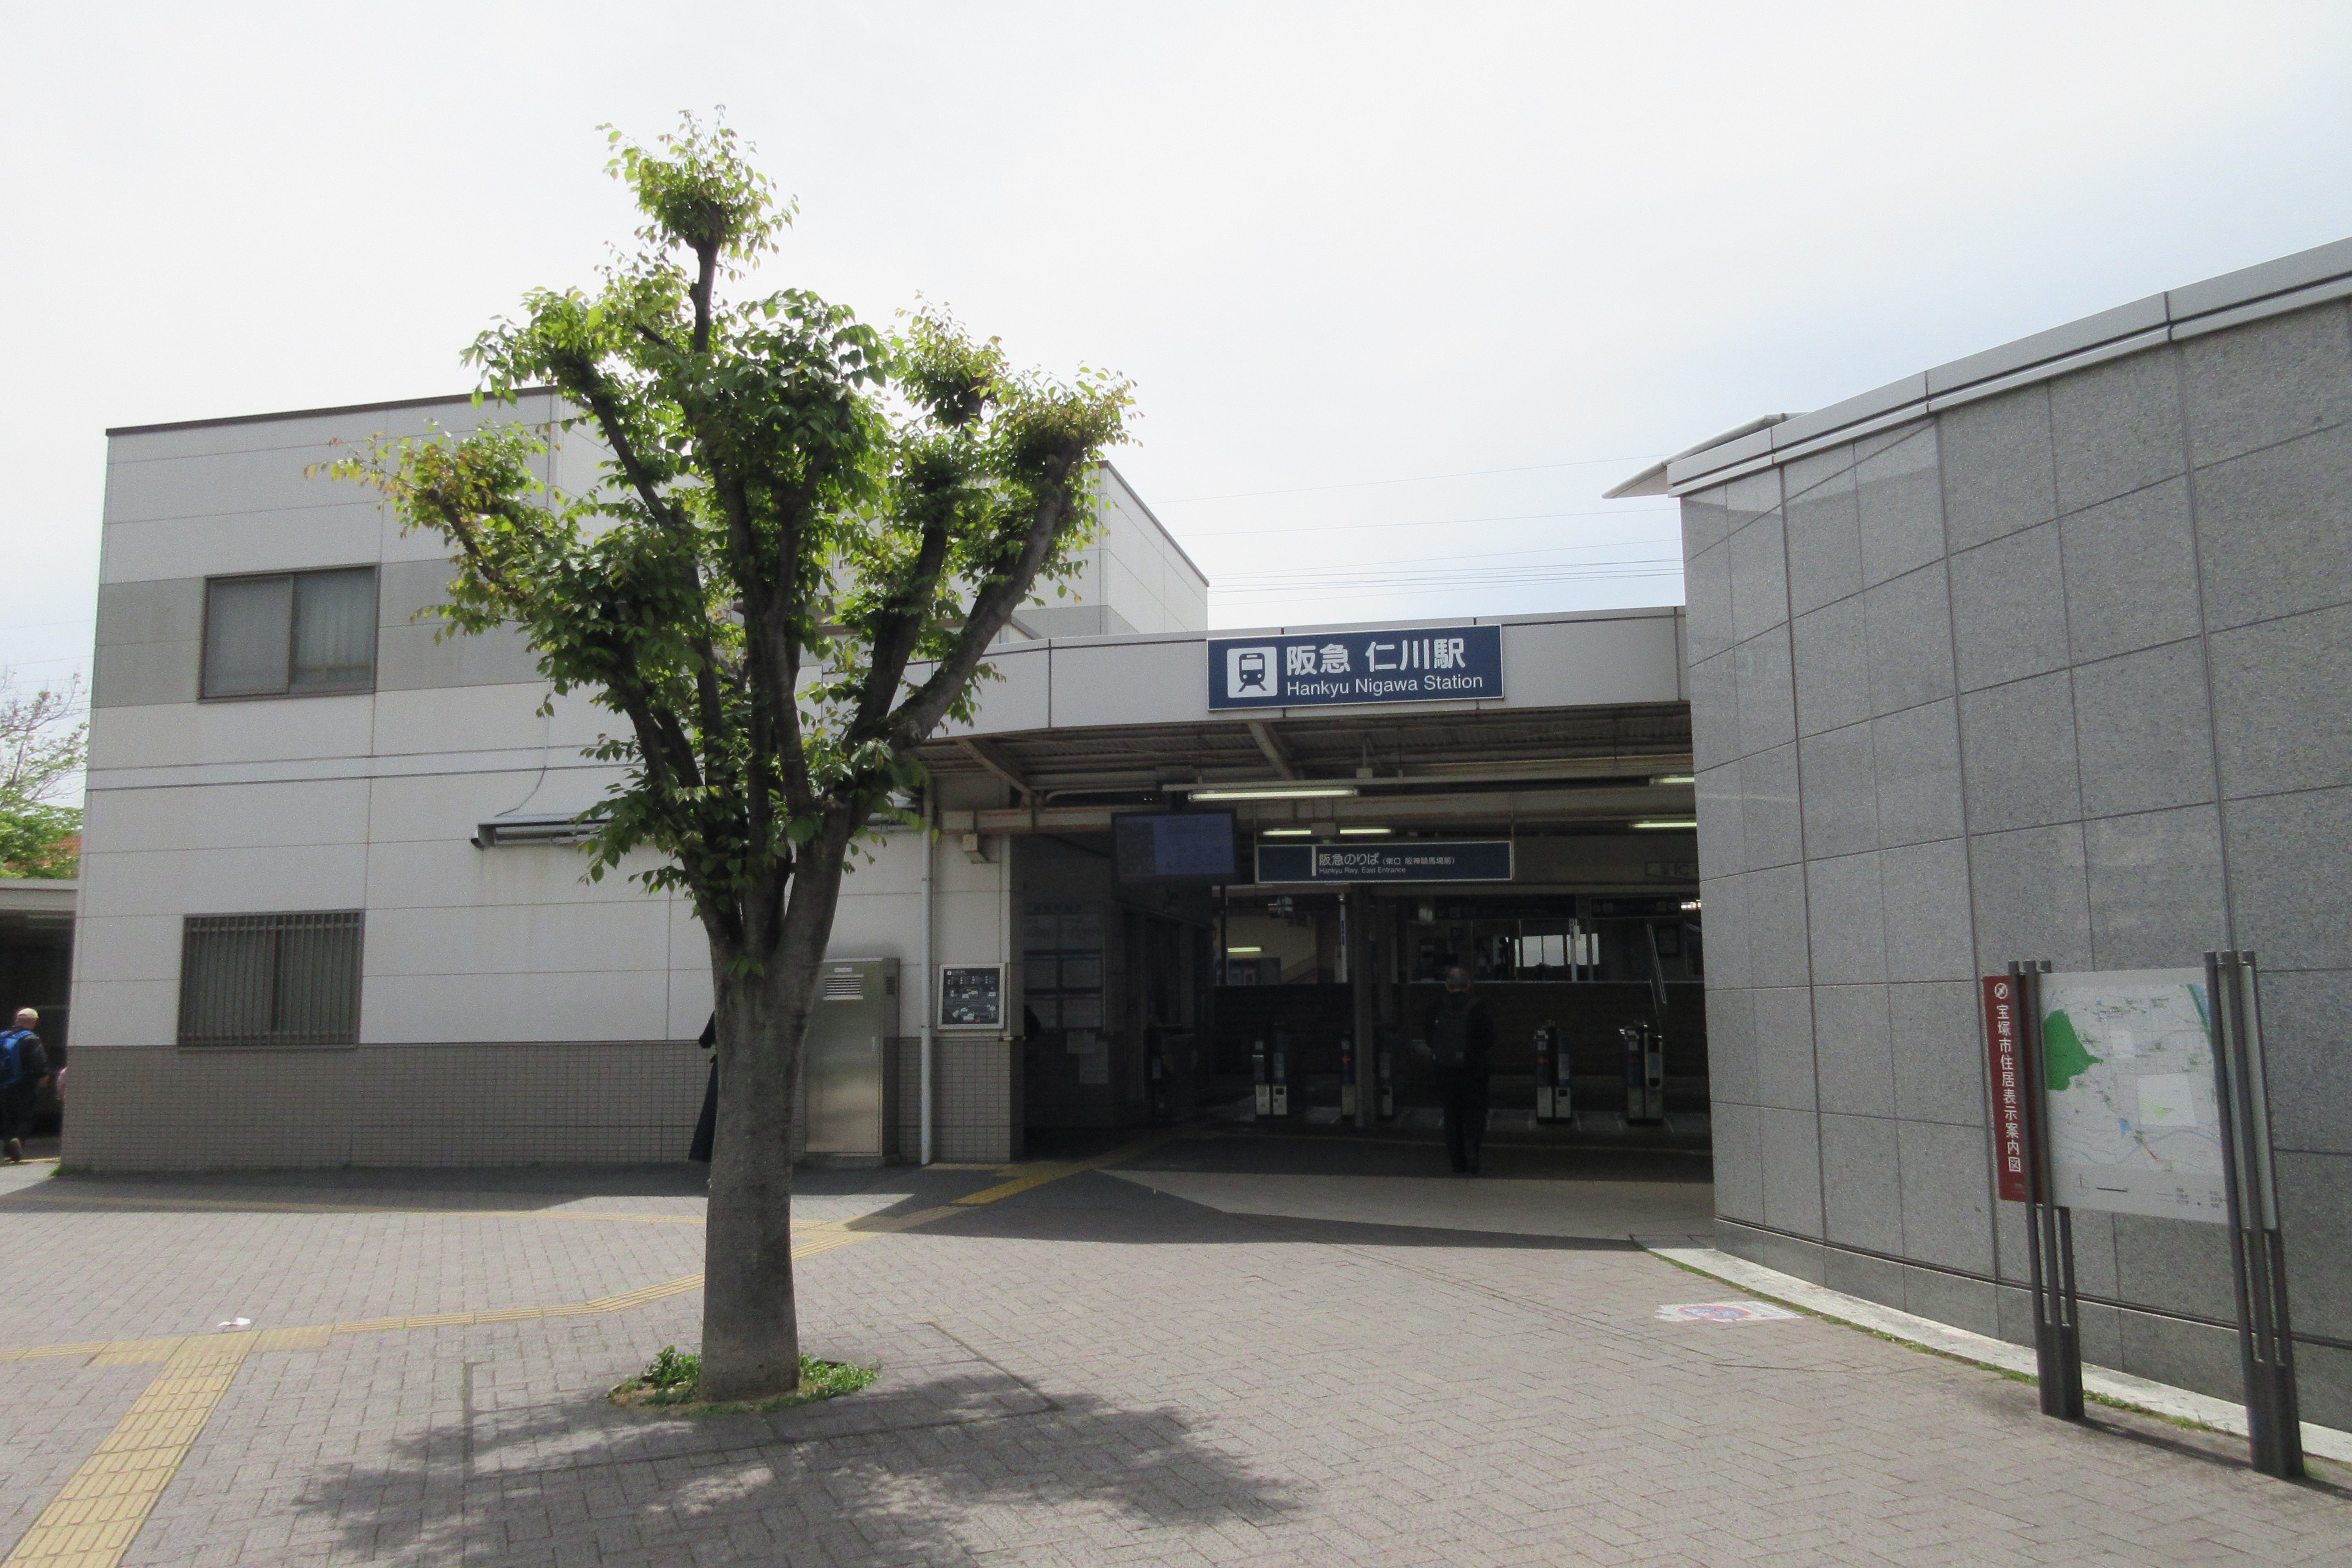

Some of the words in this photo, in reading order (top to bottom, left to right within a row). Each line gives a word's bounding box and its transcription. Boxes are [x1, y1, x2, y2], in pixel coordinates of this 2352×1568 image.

[1286, 643, 1351, 676] 阪急
[1365, 638, 1466, 672] 仁川駅
[1287, 680, 1349, 698] Hankyu
[1355, 678, 1418, 696] Nigawa
[1423, 674, 1483, 690] Station
[1319, 852, 1380, 866] 阪急のりば
[1996, 1004, 2021, 1173] 宝塚市住居表示案内図
